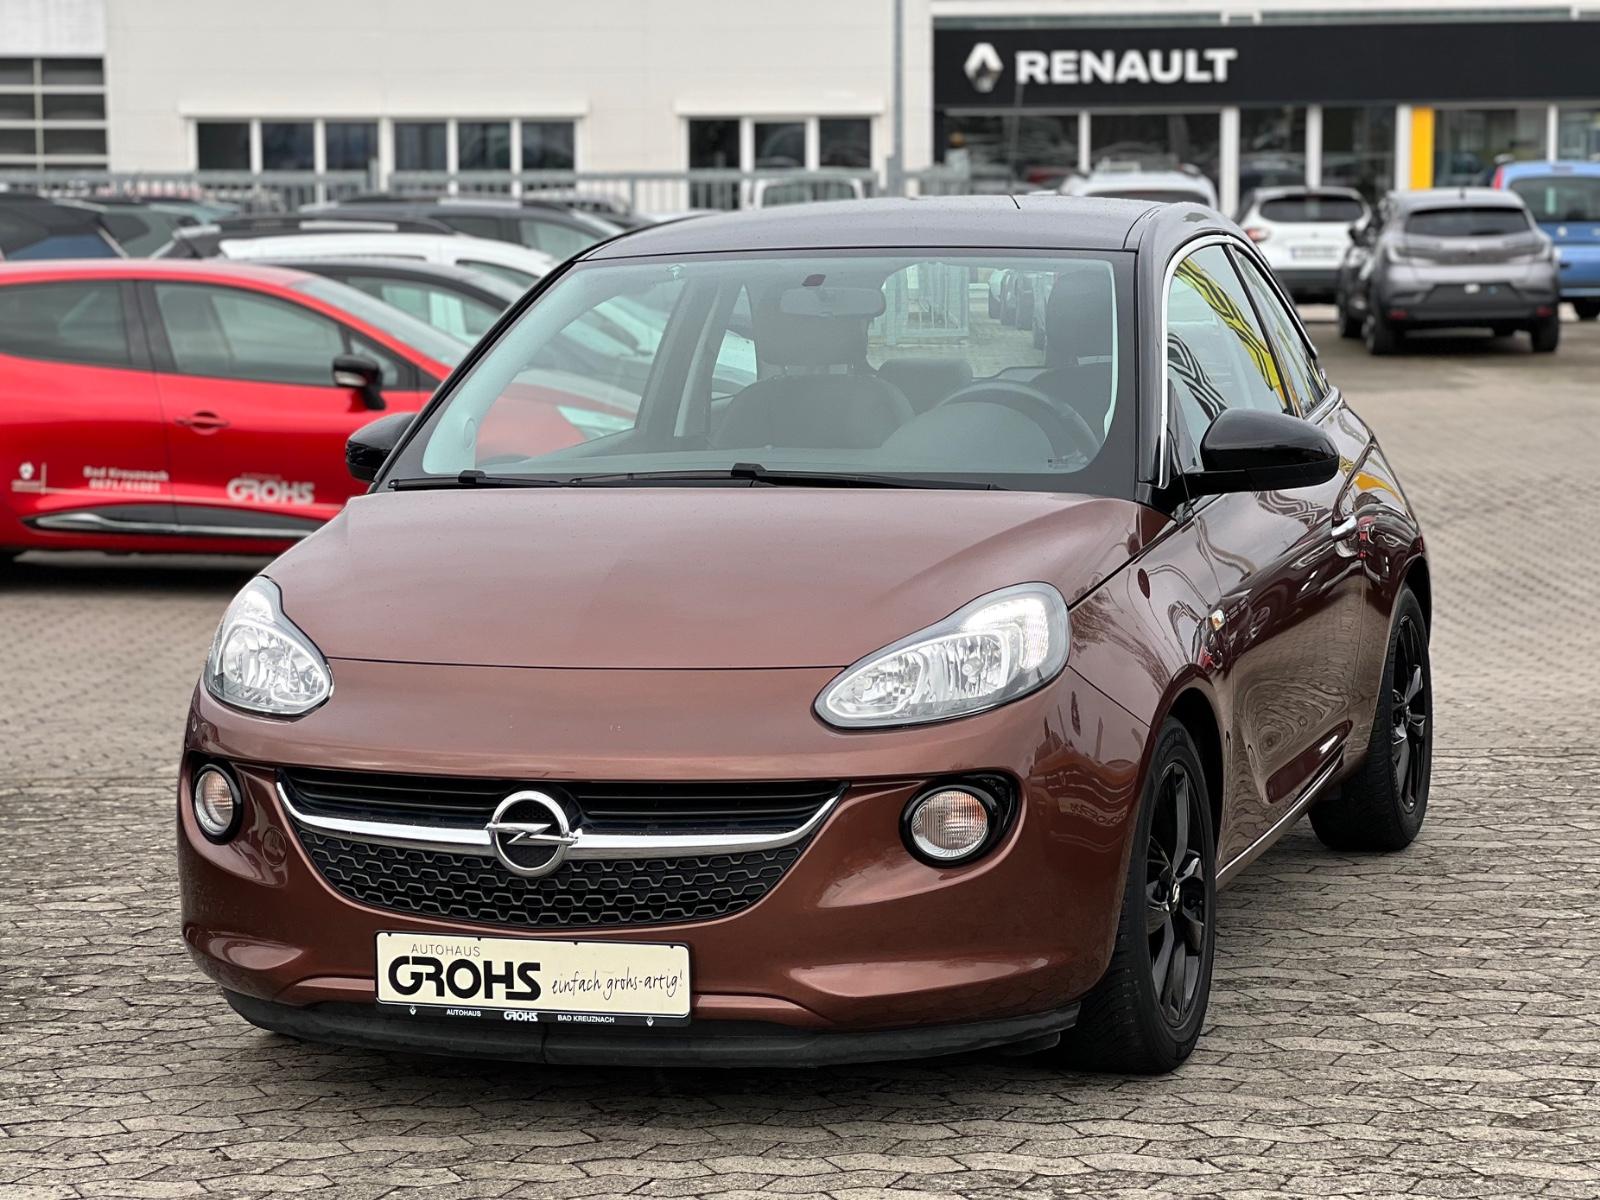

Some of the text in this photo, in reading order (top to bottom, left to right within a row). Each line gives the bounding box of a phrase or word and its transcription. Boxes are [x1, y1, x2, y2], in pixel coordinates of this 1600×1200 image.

[1015, 49, 1238, 84] RENAULT
[226, 478, 315, 504] GROHS
[411, 943, 481, 957] AUTOHAUS
[388, 955, 541, 1001] GROHS
[552, 967, 683, 1001] einfach grohs-artig!
[446, 1008, 615, 1023] AUTOHAUS GROHS BAD KREUZNACH
